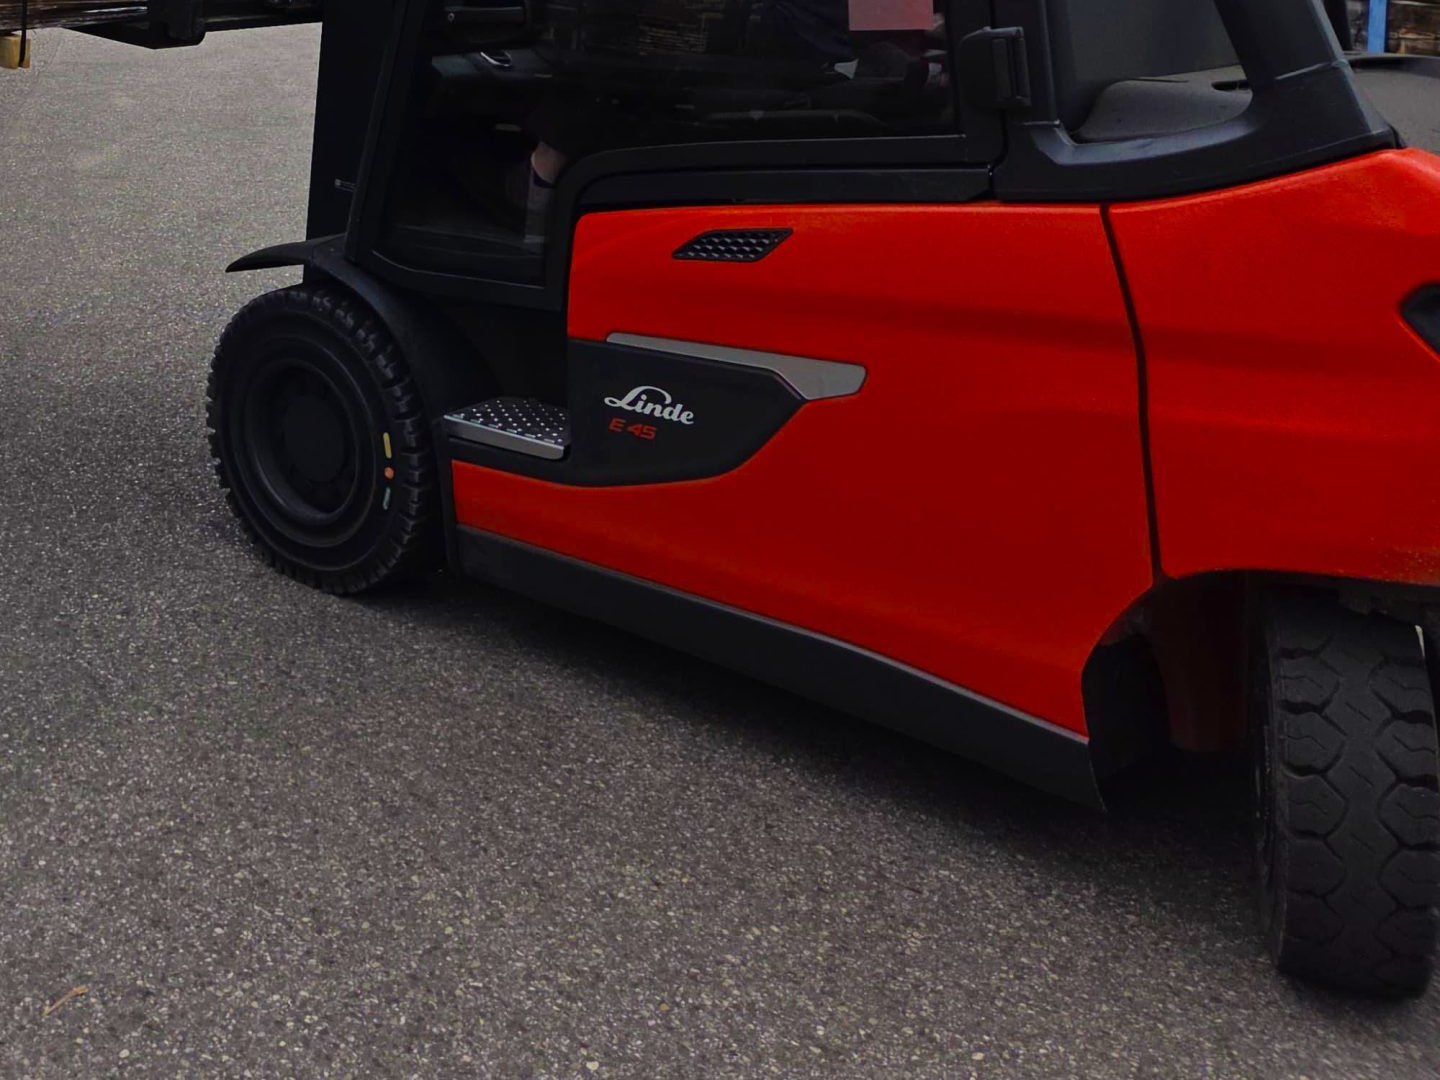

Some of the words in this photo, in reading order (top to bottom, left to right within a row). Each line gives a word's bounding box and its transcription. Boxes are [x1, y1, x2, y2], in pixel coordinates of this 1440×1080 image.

[604, 385, 694, 425] Linde
[608, 417, 626, 432] E
[627, 424, 657, 440] 45
